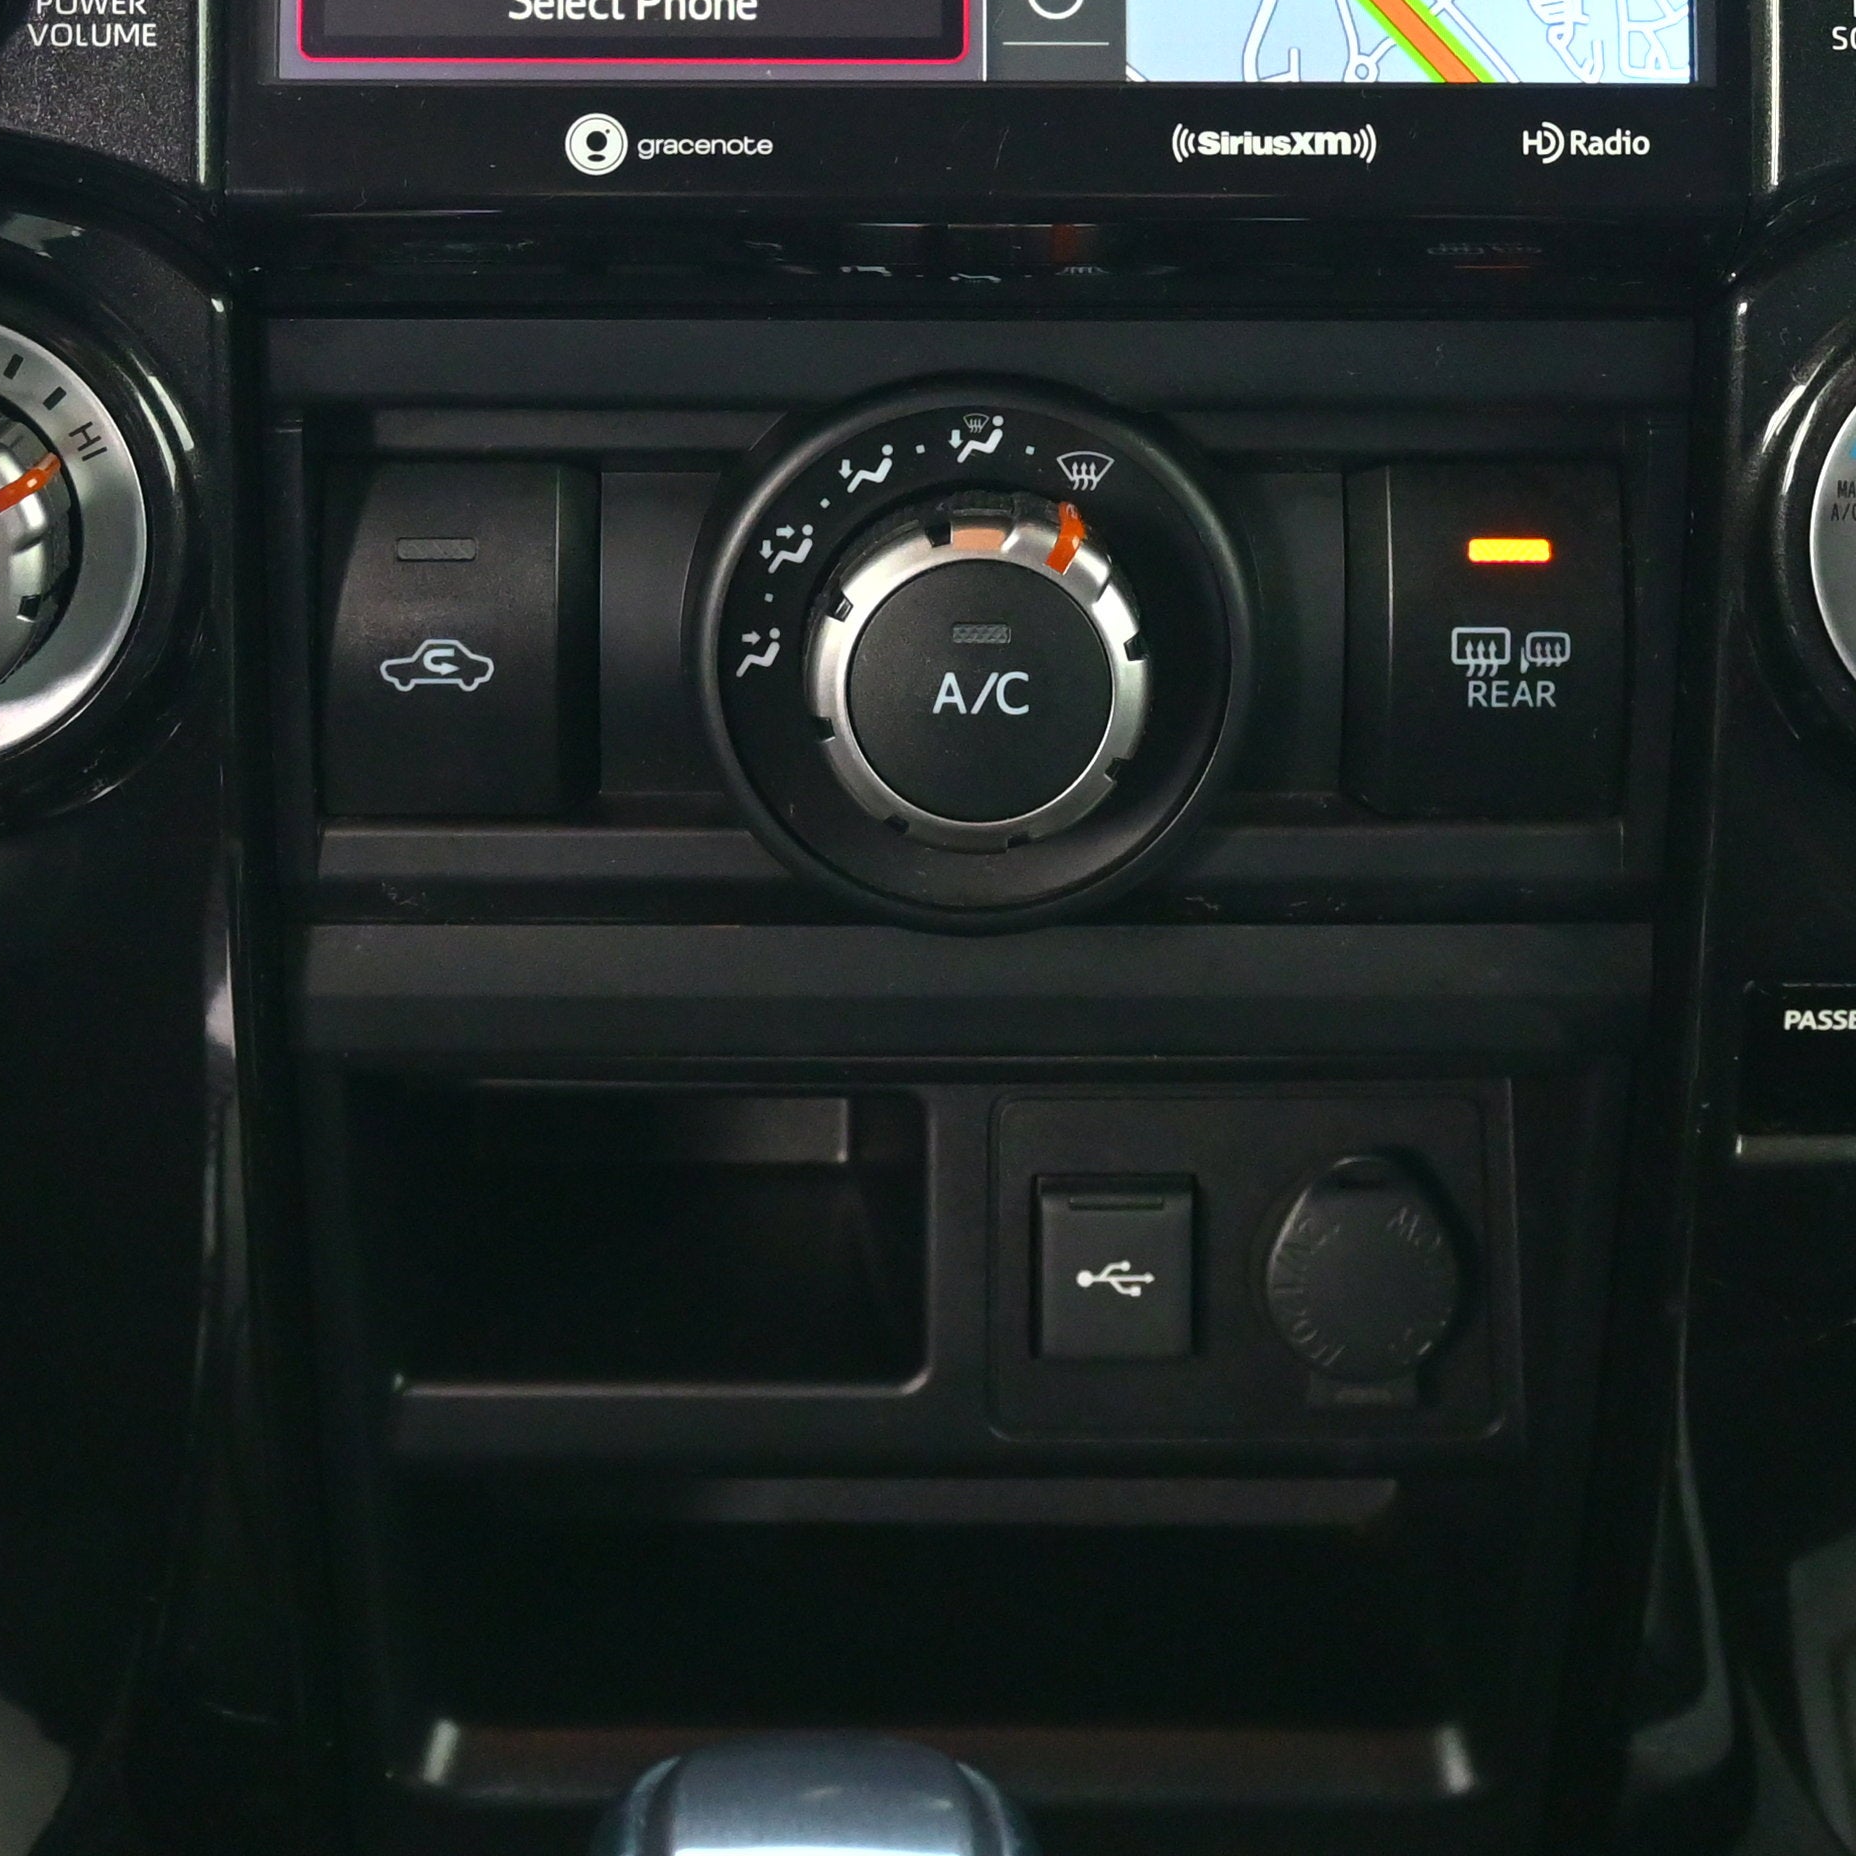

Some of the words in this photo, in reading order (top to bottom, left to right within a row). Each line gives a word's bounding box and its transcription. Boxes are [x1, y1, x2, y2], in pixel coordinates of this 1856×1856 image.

[26, 21, 158, 48] VOLUME
[637, 135, 774, 160] gracenote
[1570, 127, 1651, 156] Radio
[67, 420, 109, 462] HI
[932, 671, 1030, 716] A/C
[1467, 680, 1556, 708] REAR
